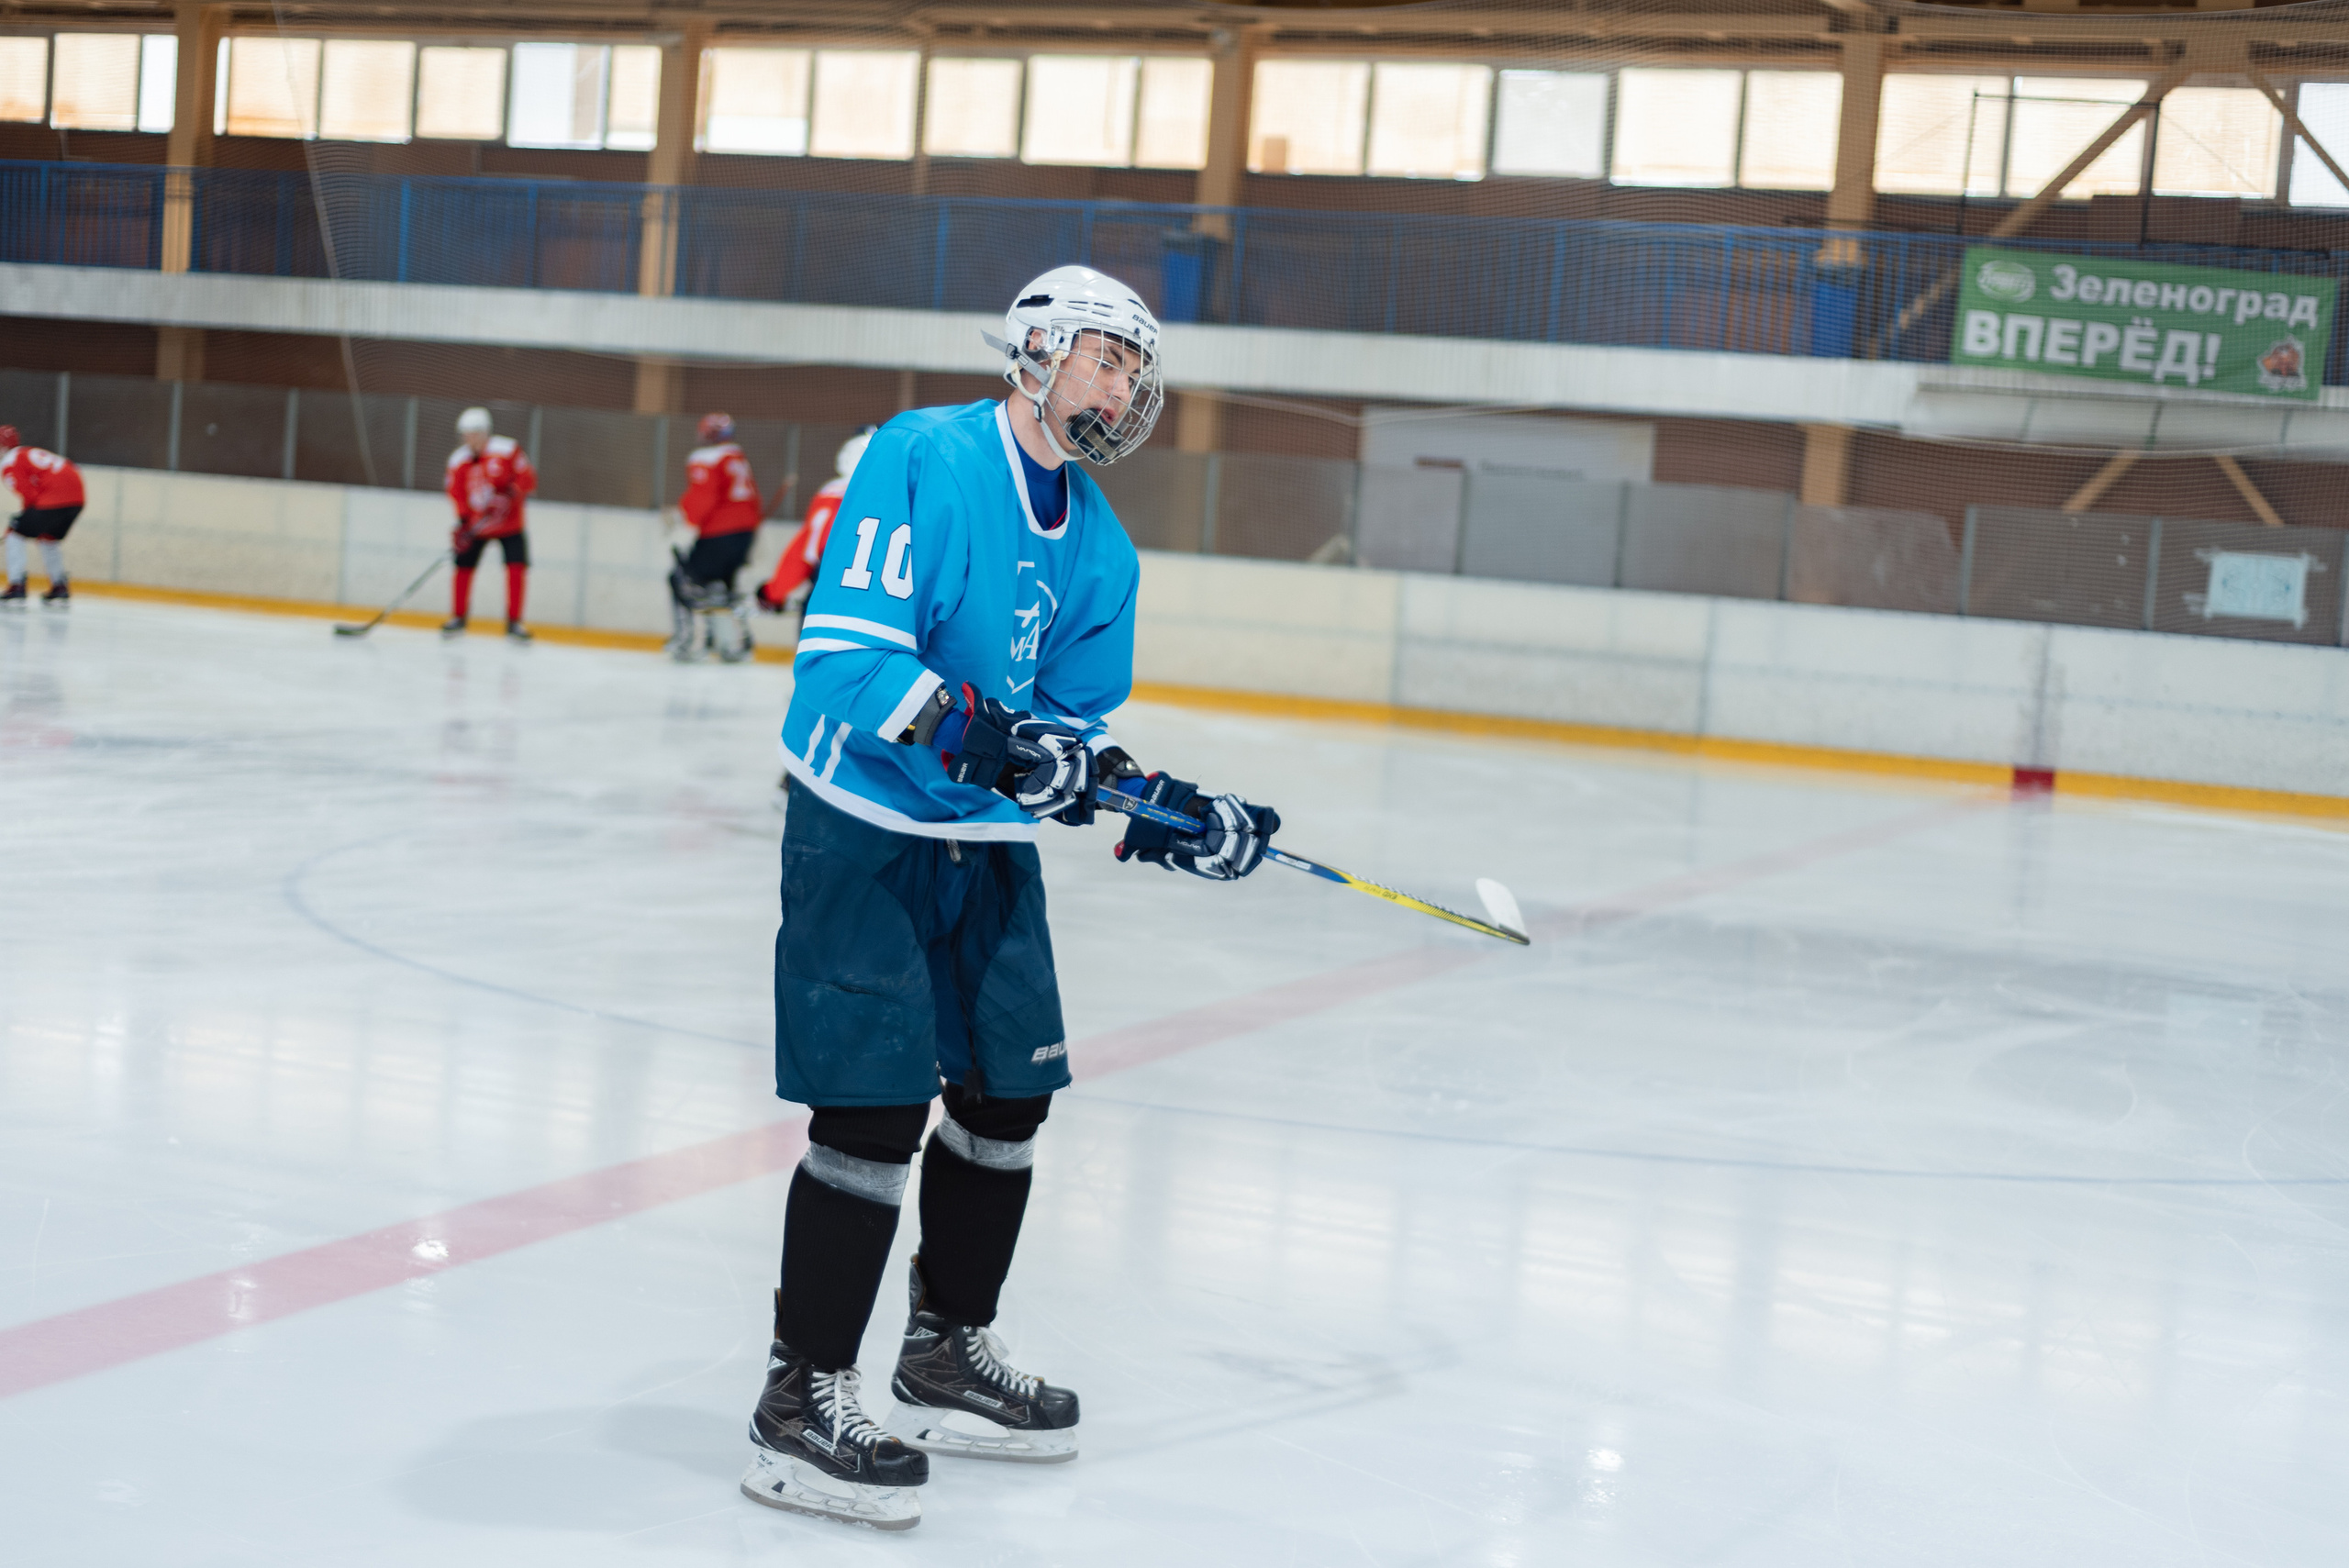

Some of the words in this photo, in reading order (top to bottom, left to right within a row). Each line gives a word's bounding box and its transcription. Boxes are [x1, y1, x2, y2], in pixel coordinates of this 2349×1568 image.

[2050, 262, 2320, 329] Зеленоград
[1962, 308, 2222, 386] ВПЕРЁД!
[840, 516, 915, 601] 10
[1031, 1040, 1065, 1062] BAU
[967, 1392, 998, 1406] BAUER
